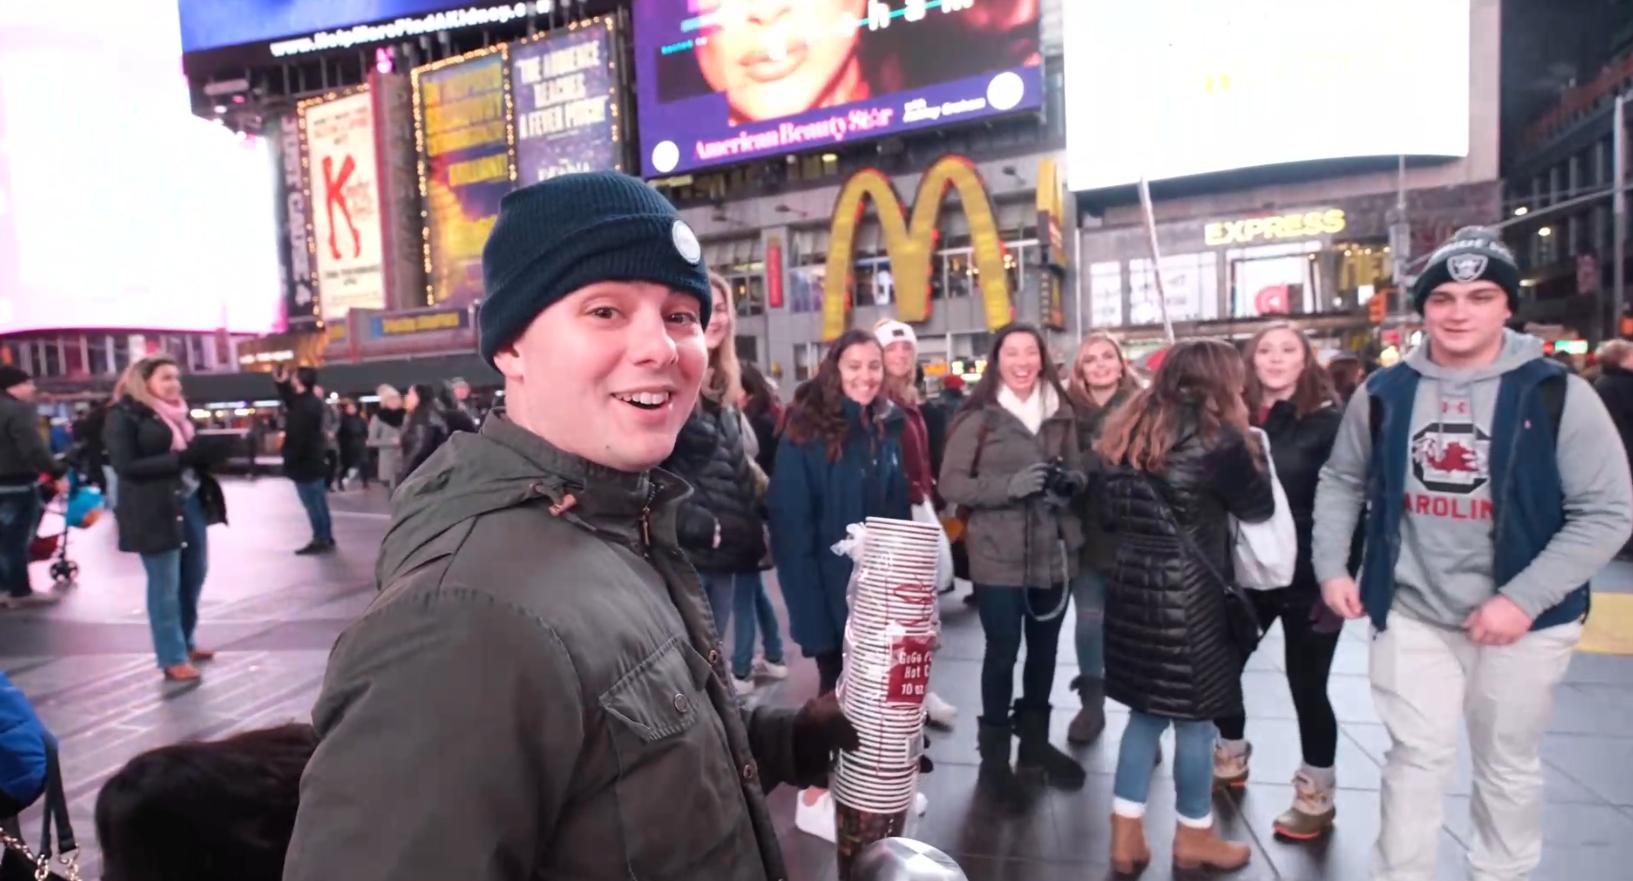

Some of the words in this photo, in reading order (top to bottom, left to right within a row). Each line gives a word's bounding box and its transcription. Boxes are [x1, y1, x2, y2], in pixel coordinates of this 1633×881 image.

[695, 130, 779, 160] American
[779, 116, 847, 142] Beauty
[1204, 208, 1346, 246] EXPRESS
[901, 683, 913, 696] 10
